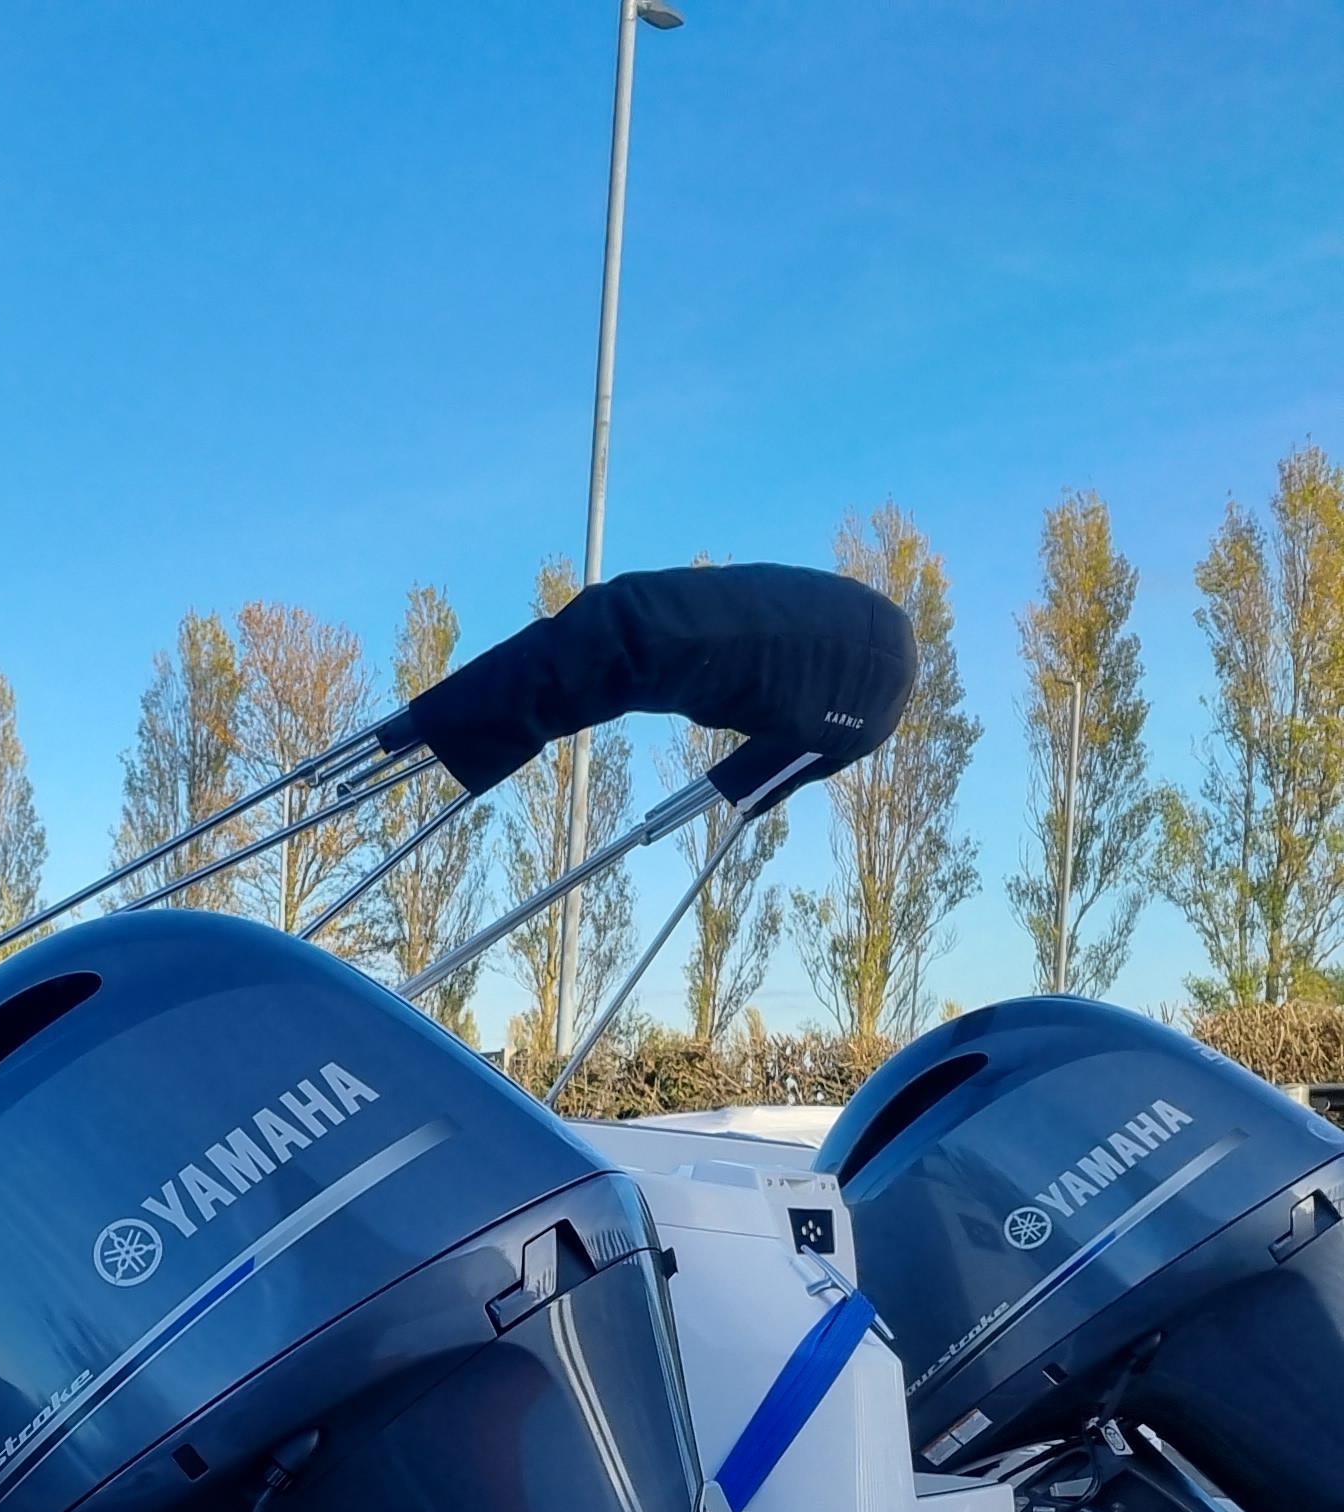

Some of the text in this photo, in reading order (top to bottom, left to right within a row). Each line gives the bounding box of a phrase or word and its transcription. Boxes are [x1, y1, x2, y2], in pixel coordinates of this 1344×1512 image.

[824, 711, 864, 729] KARNIC
[140, 1061, 380, 1239] YAMAHA
[1035, 1099, 1194, 1218] YAMAHA
[906, 1301, 1010, 1397] ourstroke
